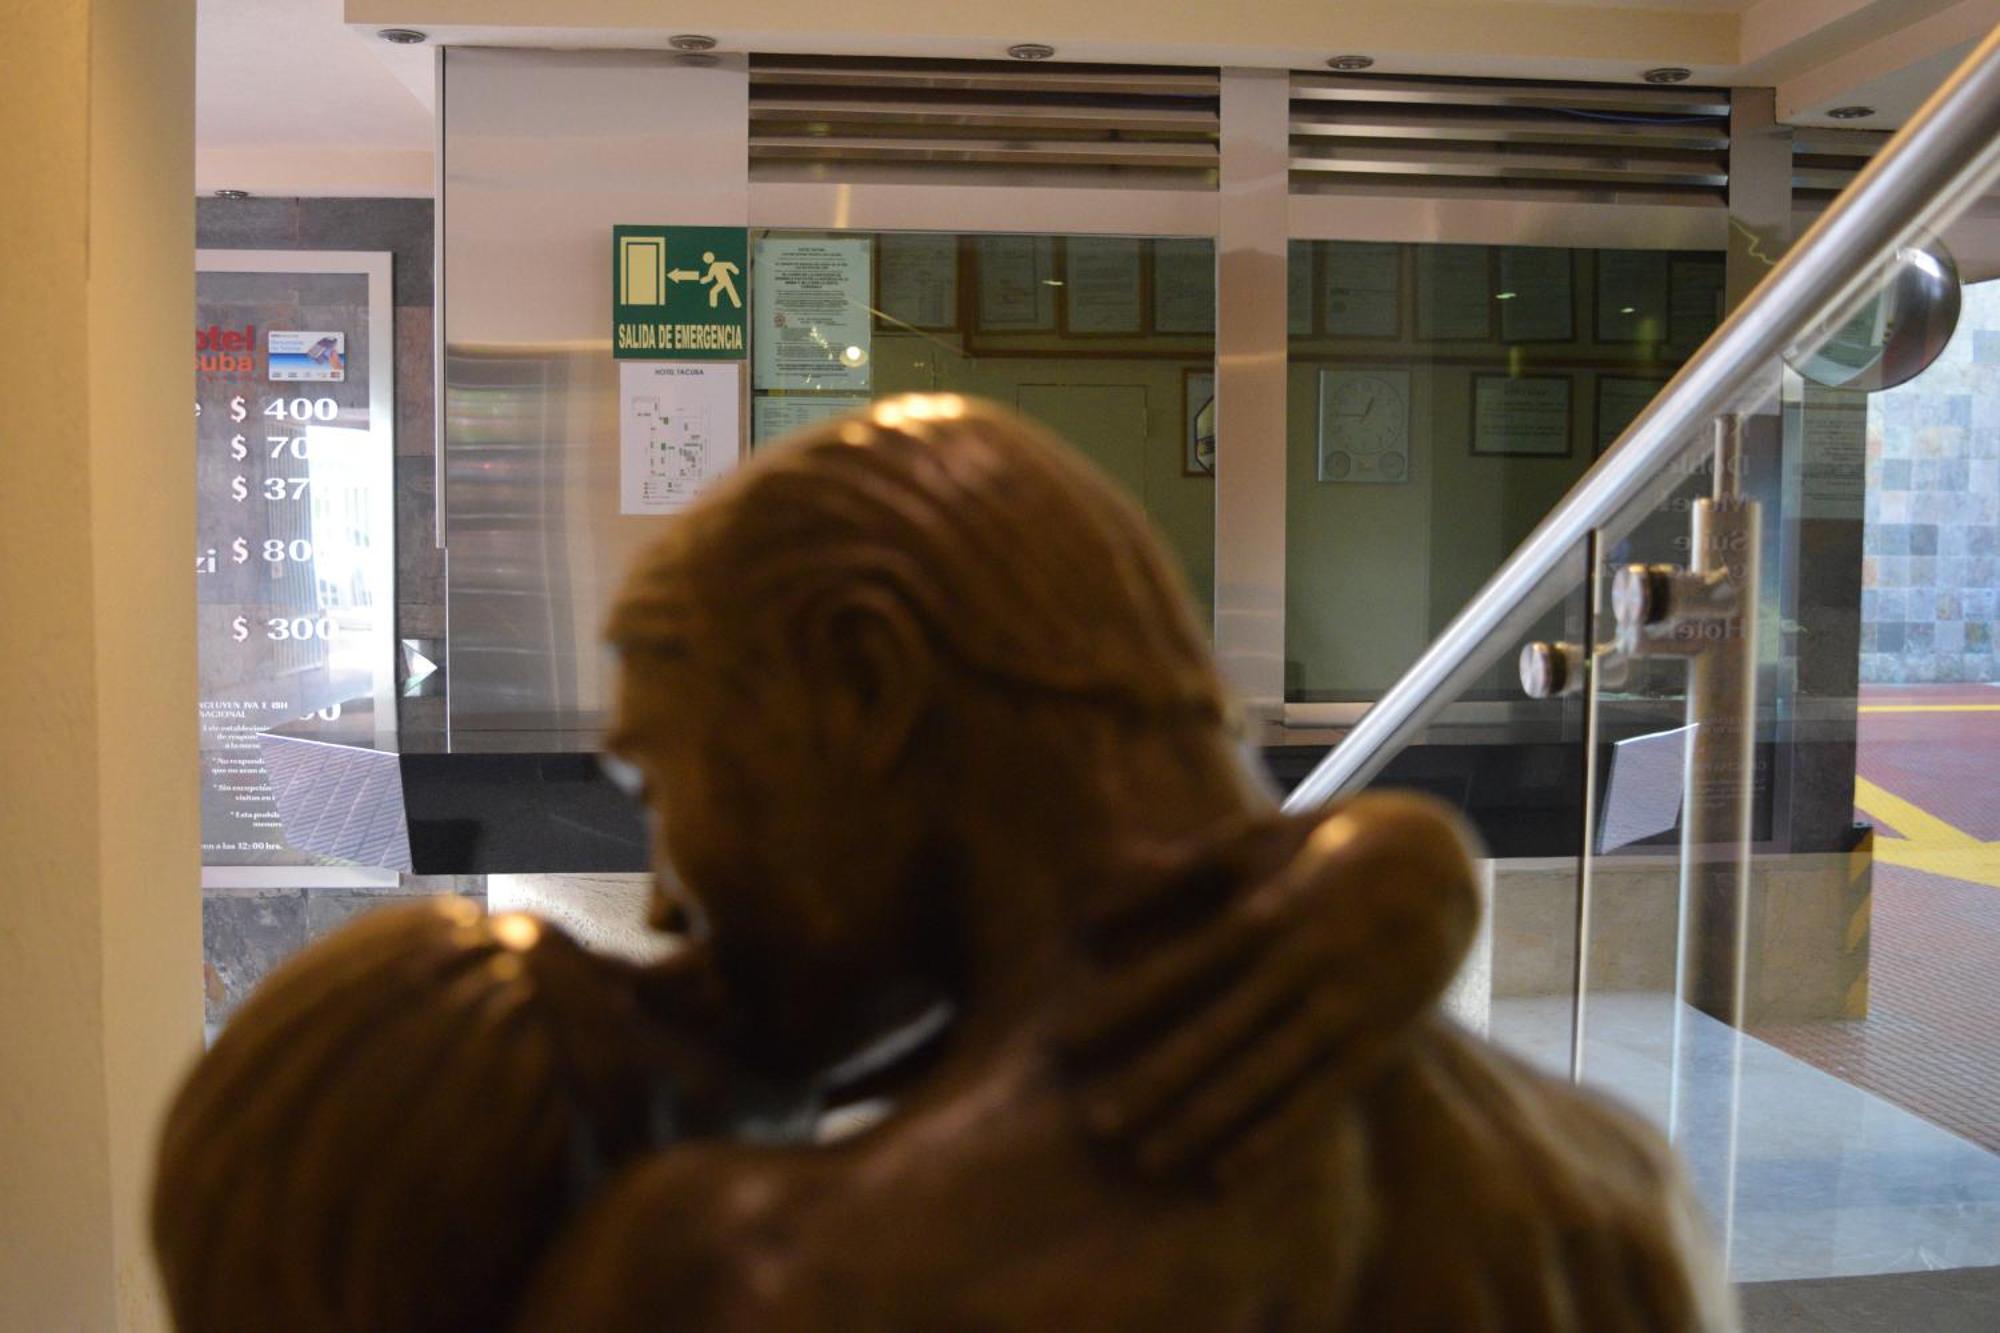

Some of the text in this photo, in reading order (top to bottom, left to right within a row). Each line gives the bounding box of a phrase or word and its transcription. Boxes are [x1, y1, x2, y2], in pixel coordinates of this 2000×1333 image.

[619, 323, 743, 350] SALIDA DE EMERGENCIA
[230, 396, 247, 423] $
[264, 398, 338, 420] 400
[231, 434, 248, 461] $
[232, 475, 248, 502] $
[232, 537, 249, 564] $
[232, 616, 336, 642] $ 300
